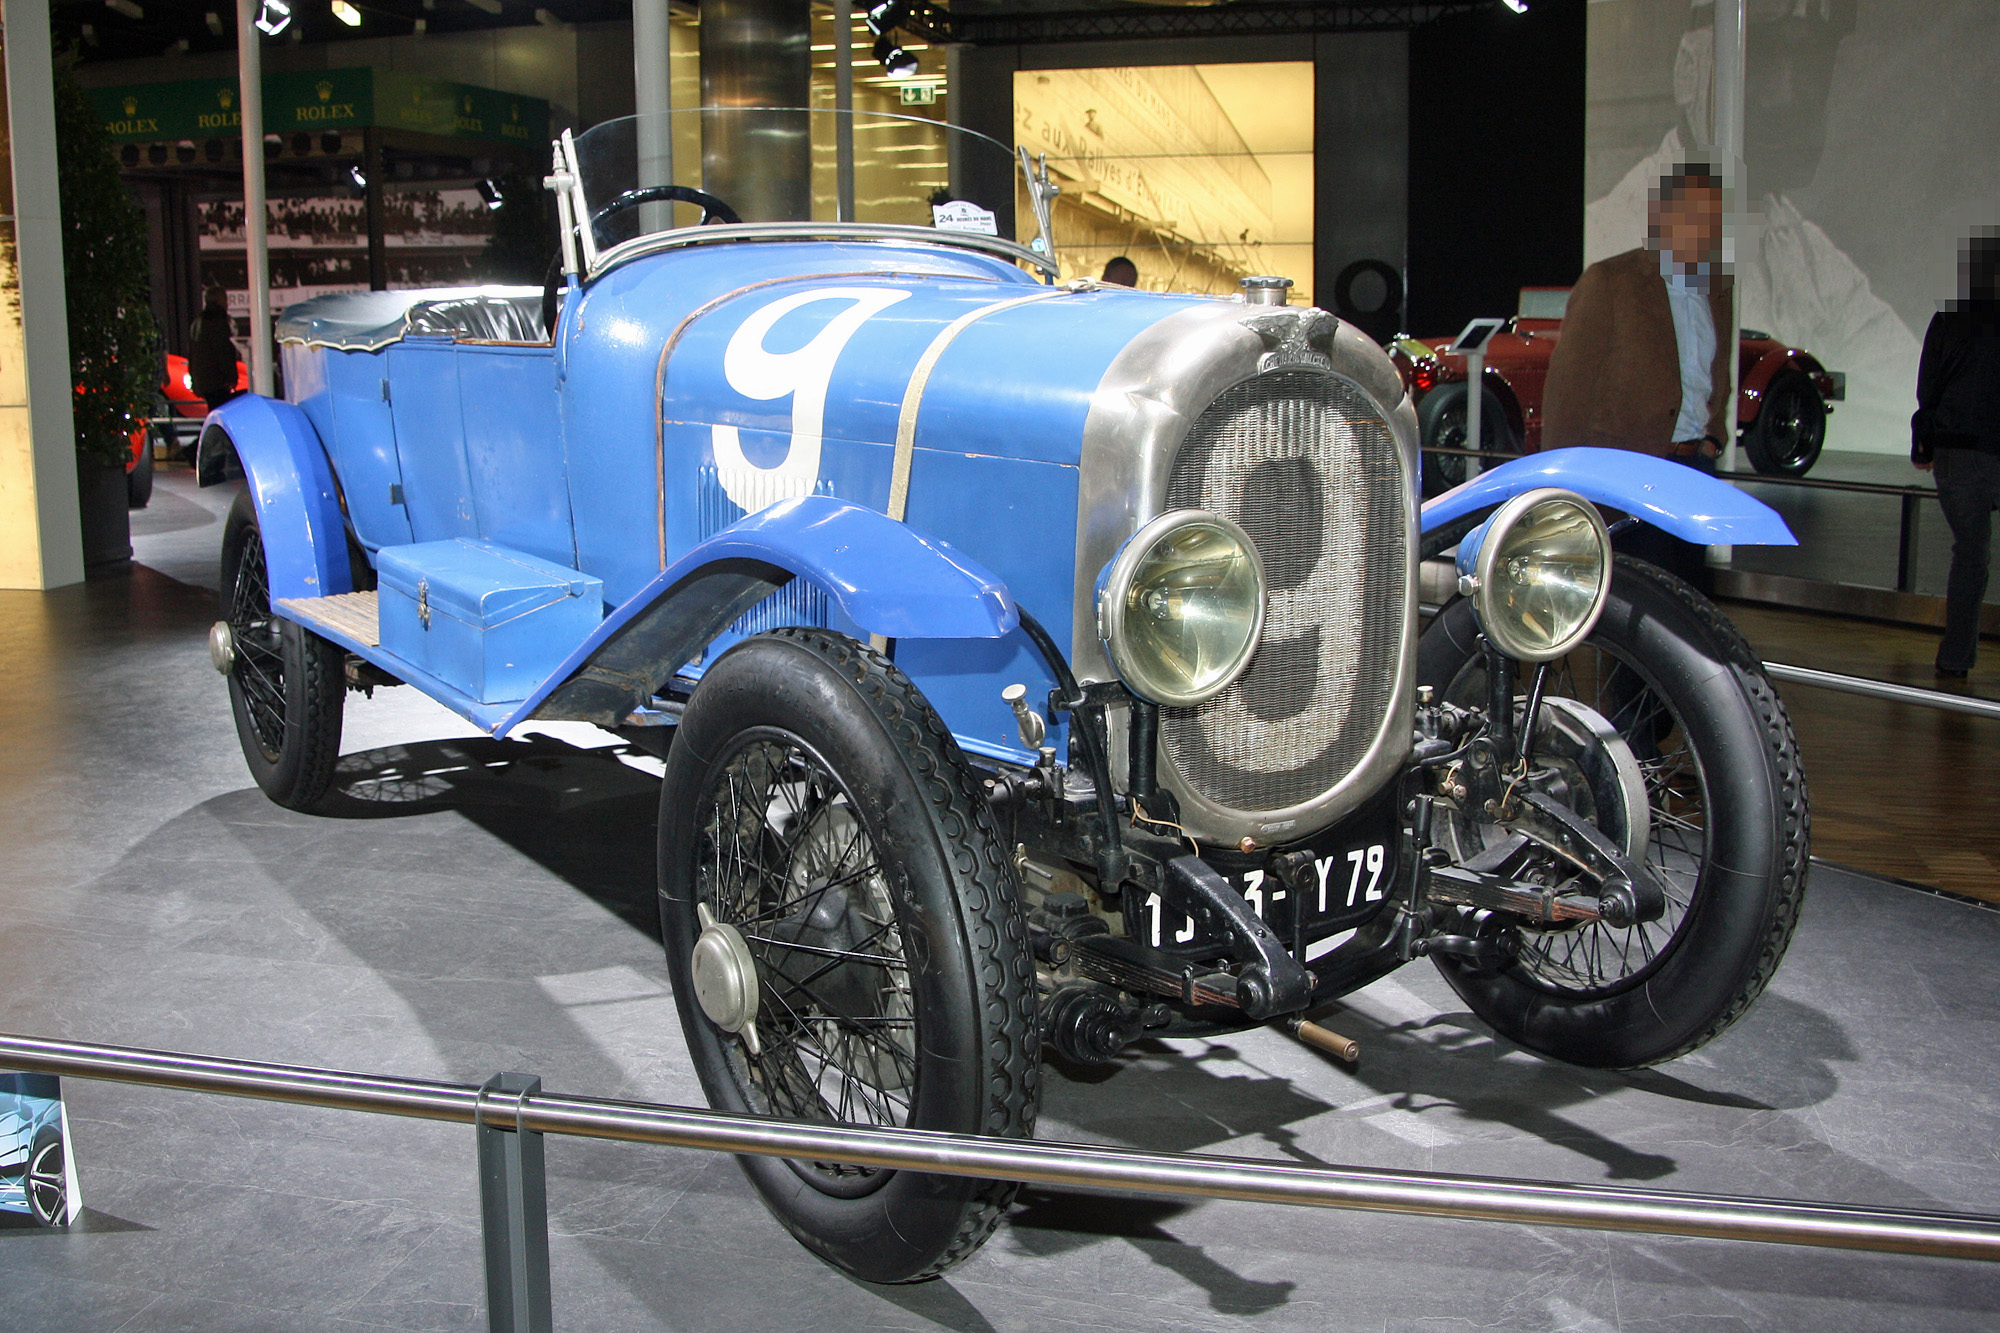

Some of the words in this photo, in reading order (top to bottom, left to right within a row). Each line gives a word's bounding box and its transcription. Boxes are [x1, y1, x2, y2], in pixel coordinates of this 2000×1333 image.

[198, 112, 241, 129] ROLE
[296, 103, 354, 122] ROLEX
[1041, 121, 1071, 156] aux
[939, 214, 953, 223] 24
[711, 287, 913, 514] 9
[1347, 844, 1385, 908] 72
